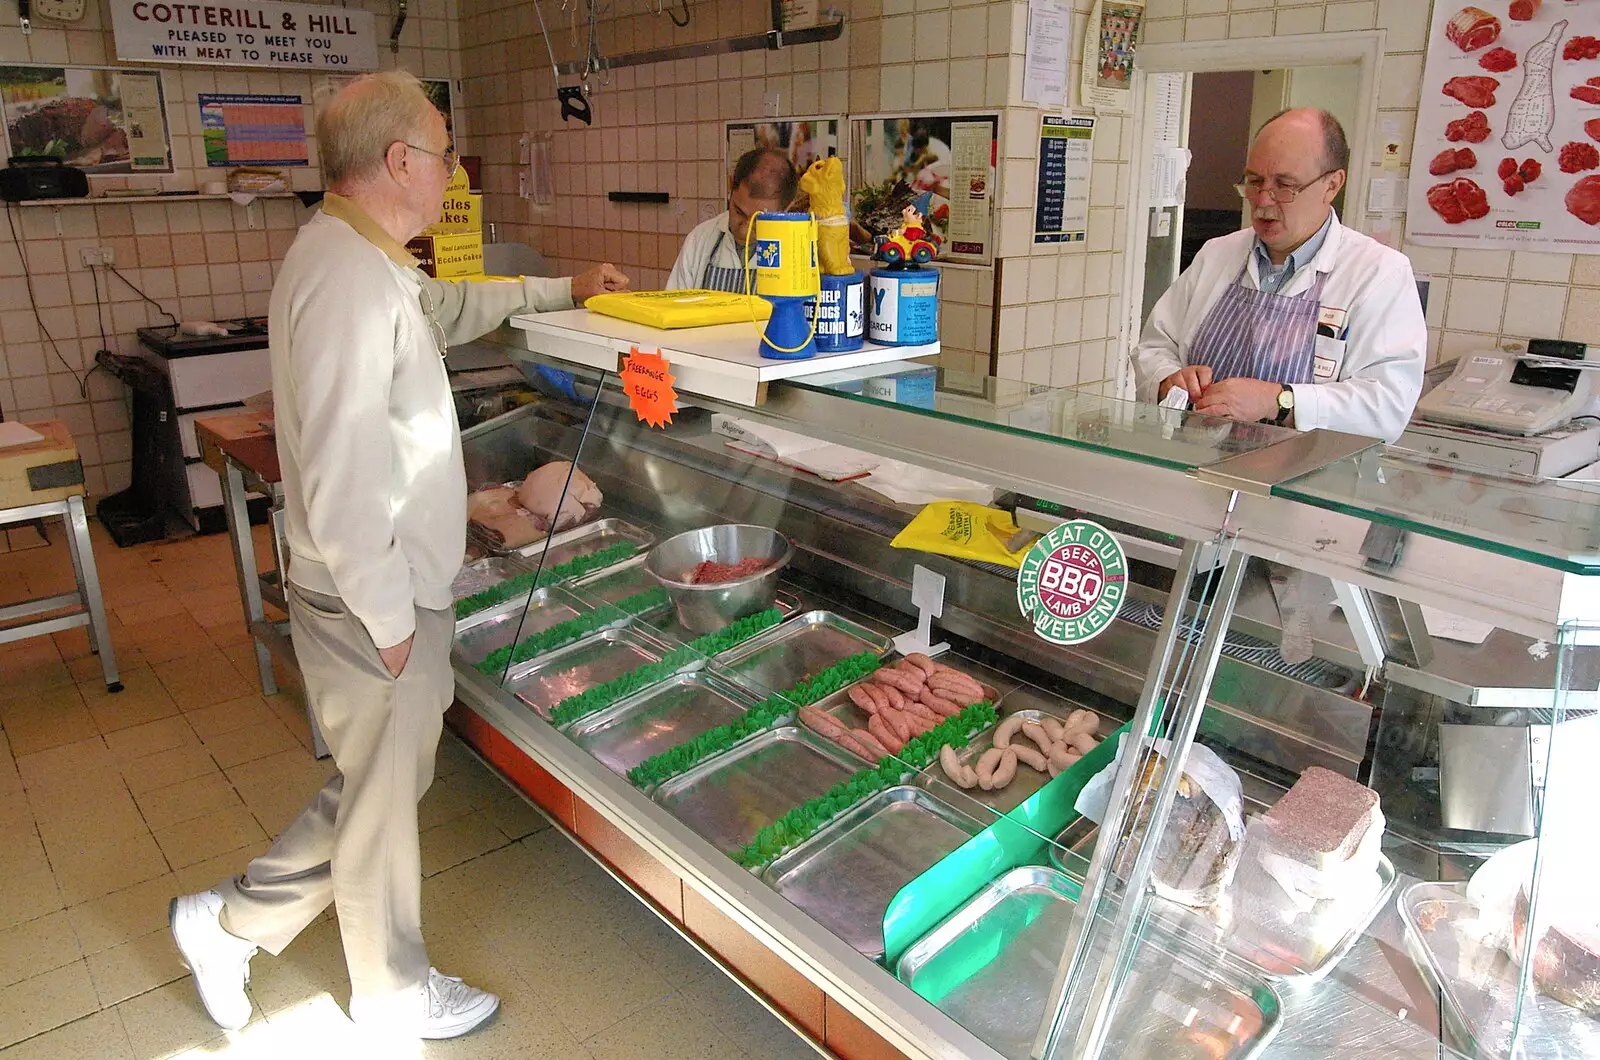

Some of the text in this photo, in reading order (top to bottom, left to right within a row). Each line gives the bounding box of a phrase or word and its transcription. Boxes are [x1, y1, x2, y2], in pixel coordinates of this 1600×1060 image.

[132, 1, 357, 35] COTTERILL & HILL
[168, 29, 332, 50] PLEASED TO MEET YOU
[152, 44, 348, 65] WITH MEAT TO PLEASE YOU
[442, 198, 471, 210] cles
[440, 211, 469, 224] kes
[819, 290, 841, 303] HELP
[818, 321, 845, 335] BLIND
[635, 385, 659, 403] EGGS
[1047, 525, 1122, 569] EAT OUT
[1061, 547, 1098, 569] BEEF
[1021, 558, 1042, 610] THIS
[1040, 560, 1102, 606] BBQ
[1035, 585, 1120, 639] WEEKEND
[1046, 594, 1082, 616] LAMB
